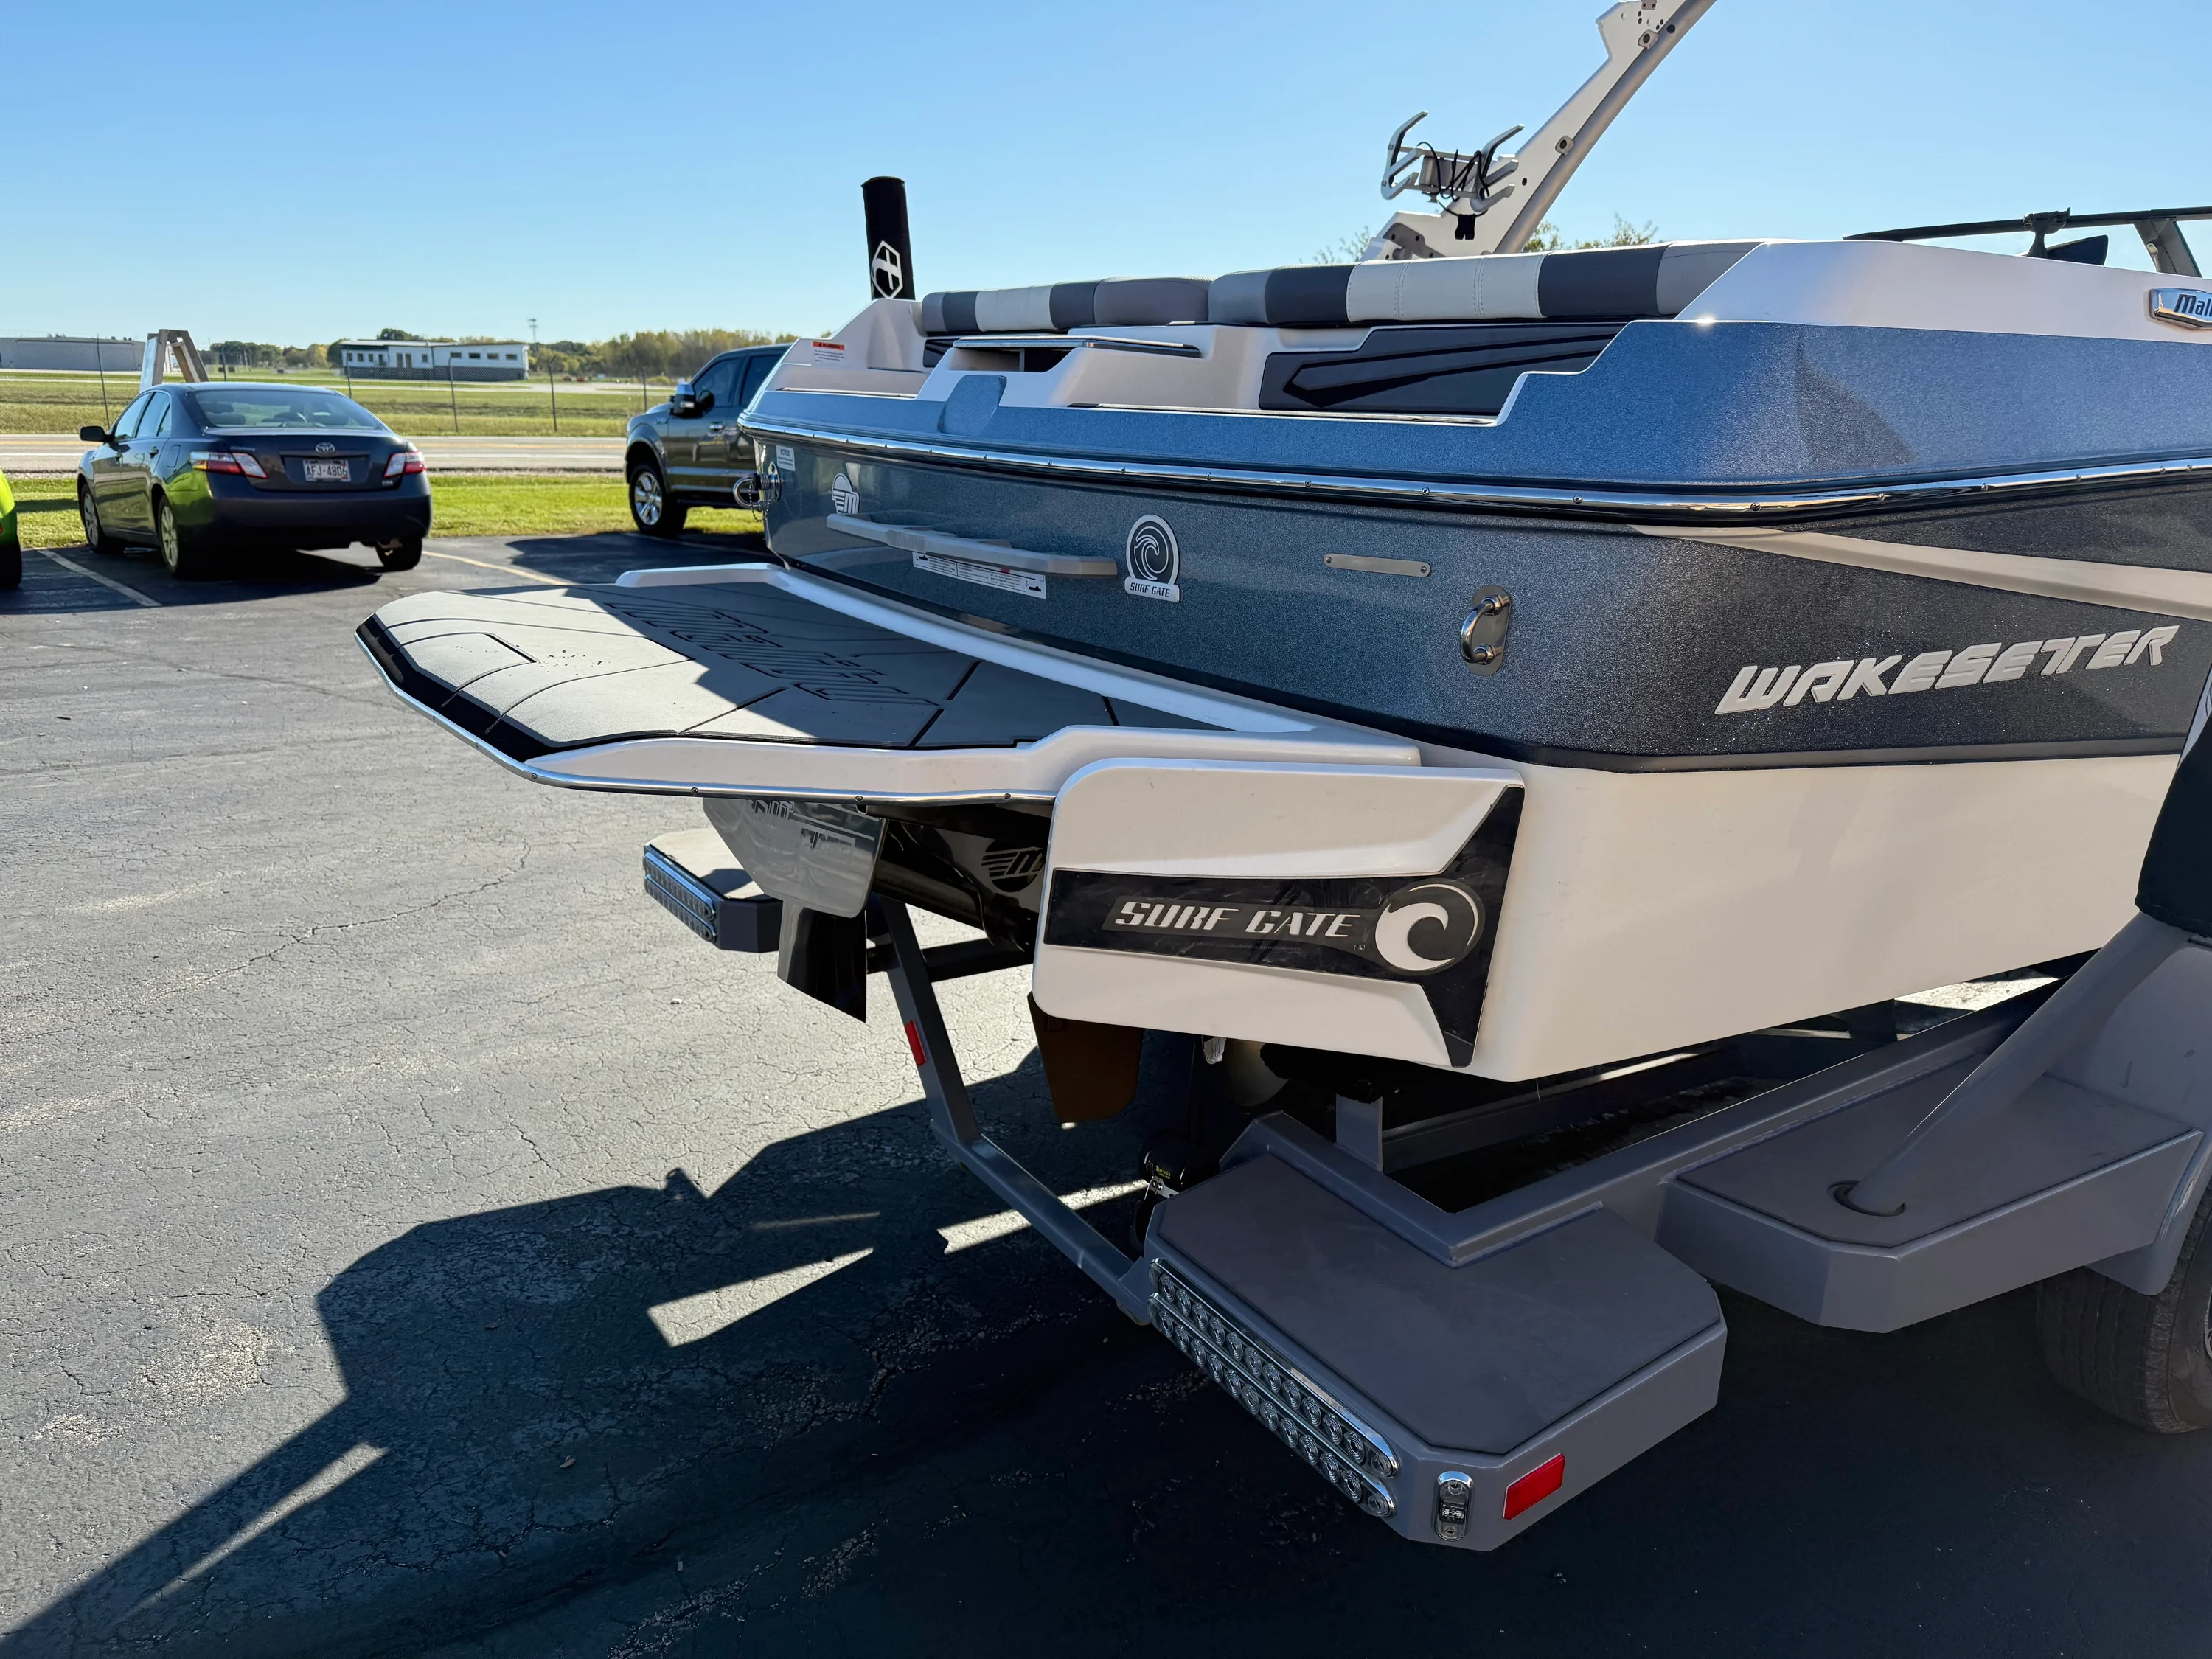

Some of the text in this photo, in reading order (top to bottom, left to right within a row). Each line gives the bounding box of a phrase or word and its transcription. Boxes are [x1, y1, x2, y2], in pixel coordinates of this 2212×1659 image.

[2173, 293, 2212, 317] Mal
[1130, 582, 1171, 597] SURF GATE
[1714, 625, 2180, 714] WAKESETTER
[1114, 901, 1362, 937] SURF GATE
